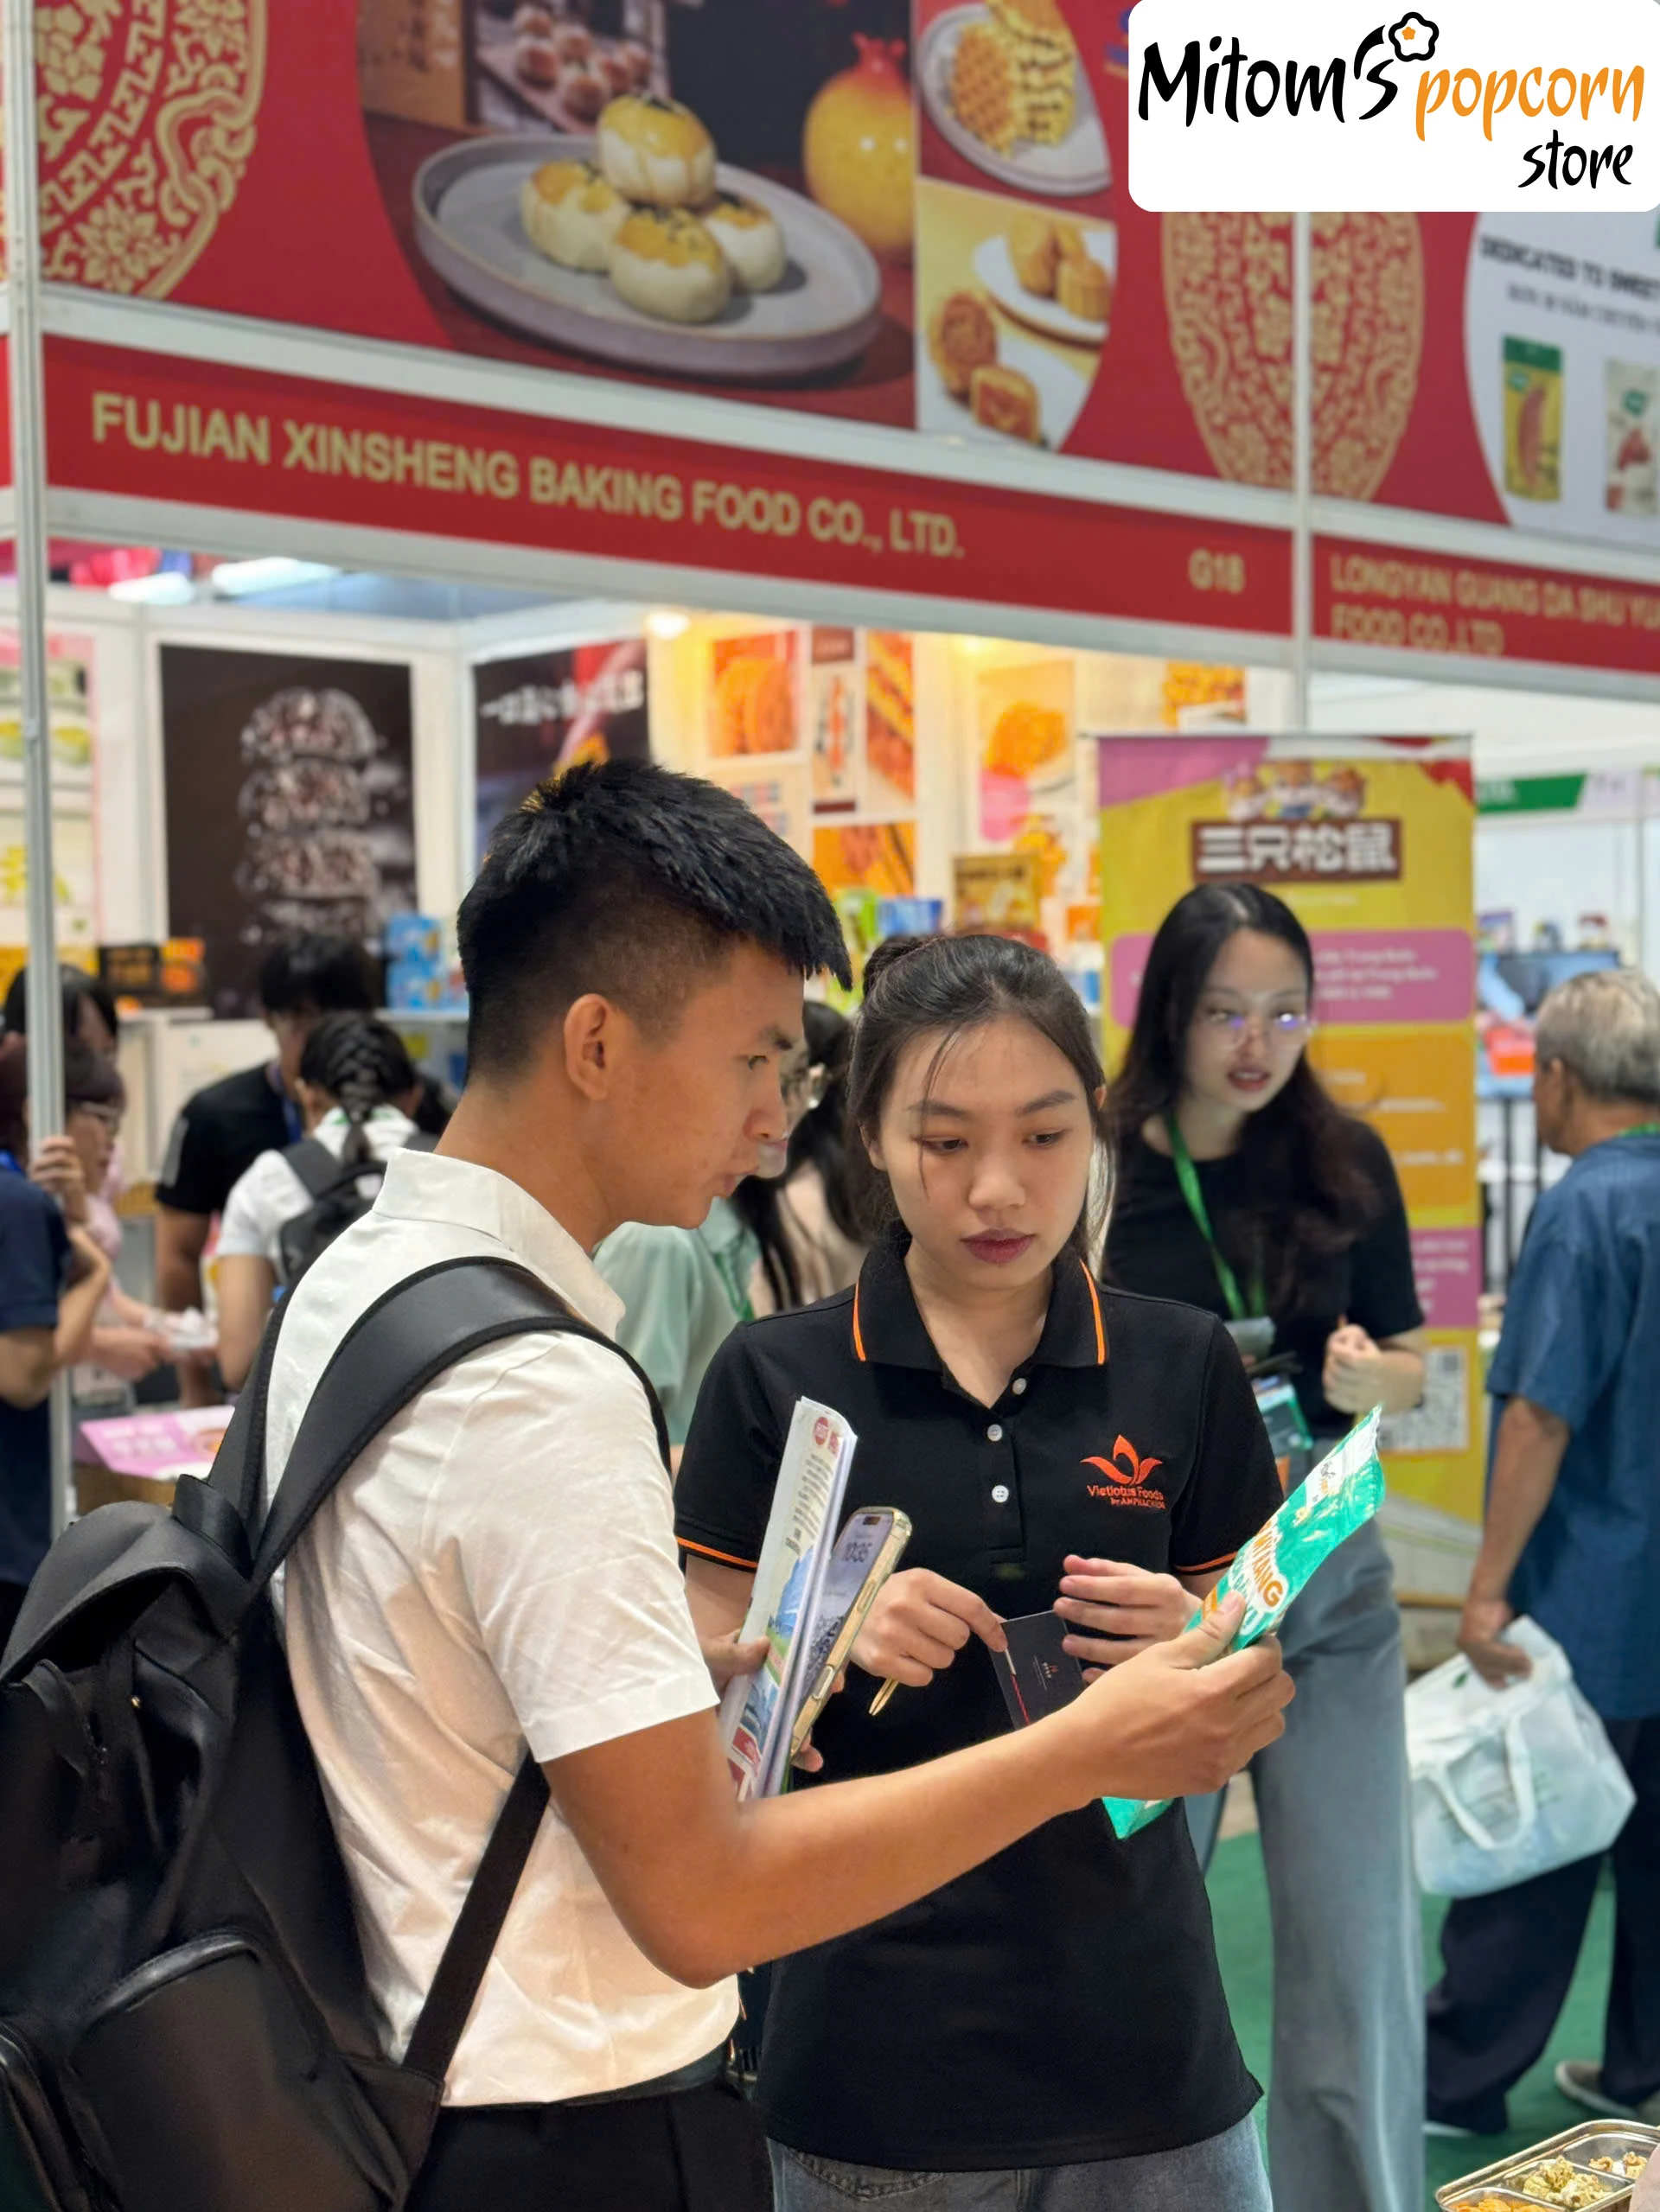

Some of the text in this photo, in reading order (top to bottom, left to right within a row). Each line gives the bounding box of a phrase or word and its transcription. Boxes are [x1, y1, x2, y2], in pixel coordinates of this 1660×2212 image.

[92, 392, 965, 559] FUJIAN XINSHENG BAKING FOOD CO., LTD.
[1331, 553, 1452, 603] LONGYAN
[1197, 823, 1398, 874] 三只松鼠
[1137, 1486, 1164, 1501] Foods
